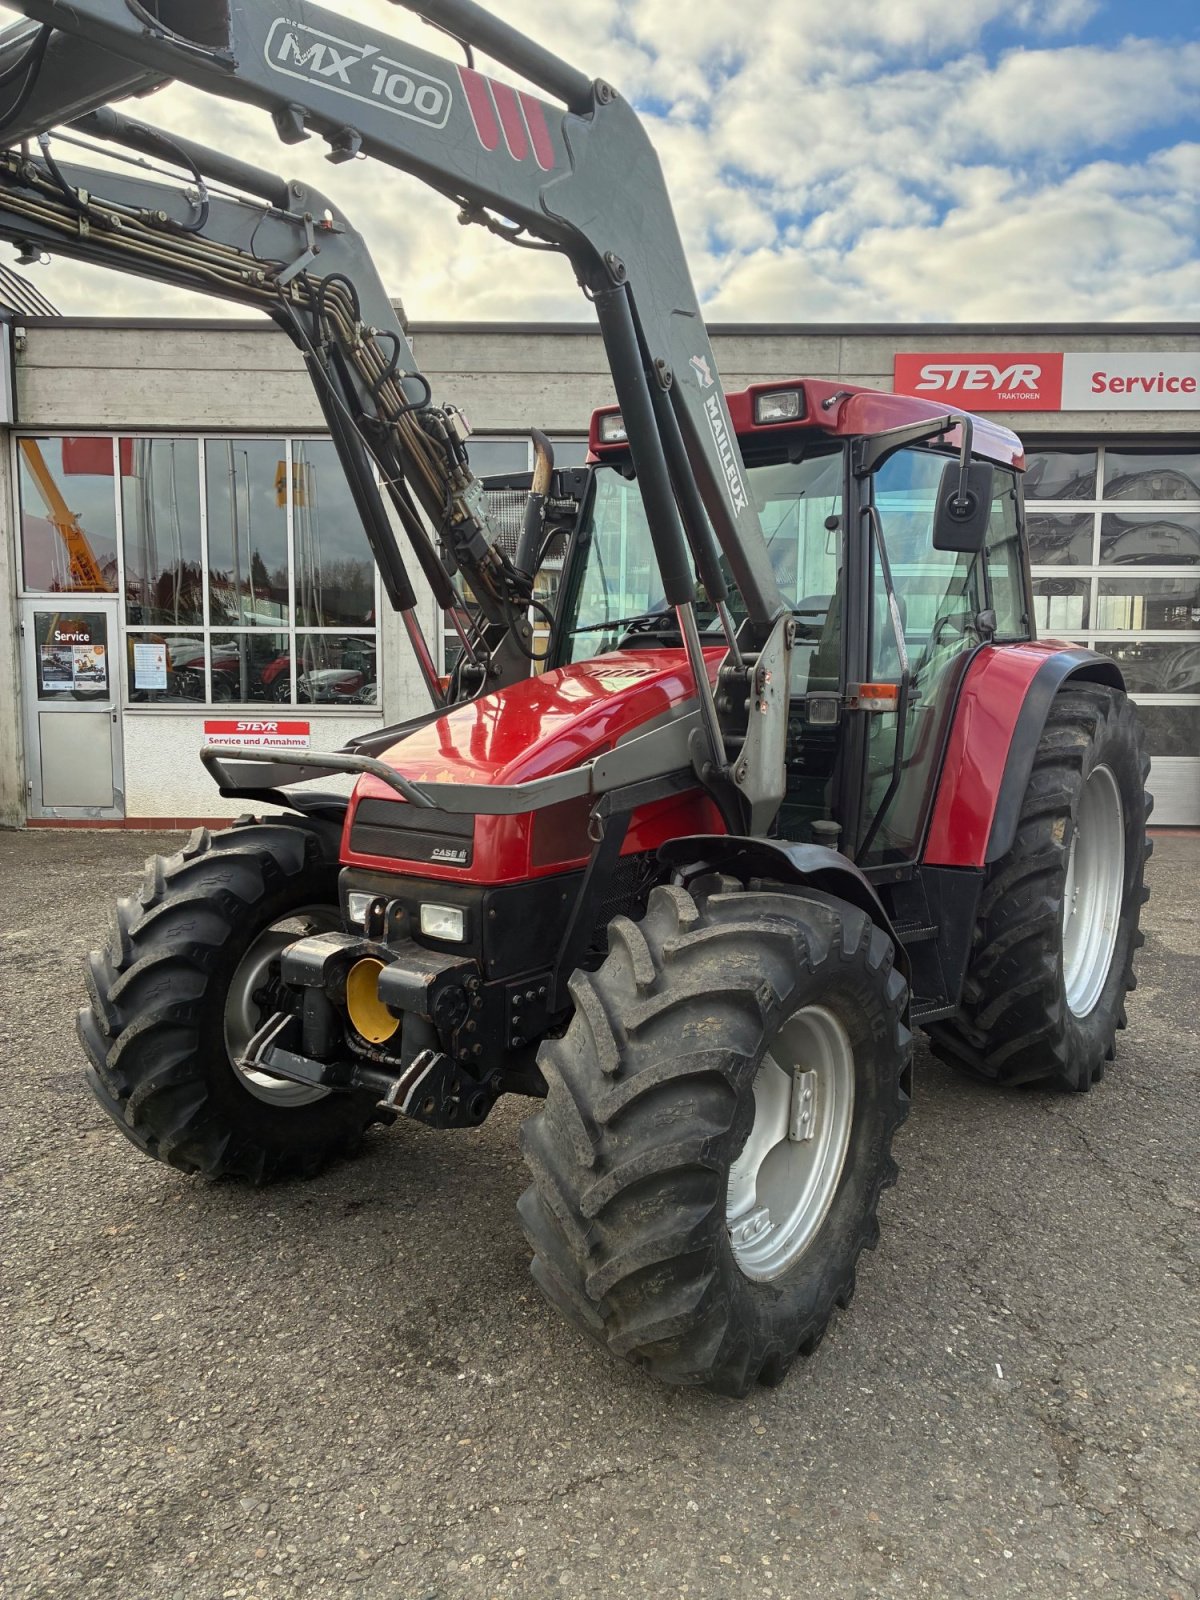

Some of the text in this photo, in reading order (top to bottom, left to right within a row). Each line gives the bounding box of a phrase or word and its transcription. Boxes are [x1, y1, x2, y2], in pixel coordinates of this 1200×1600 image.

[277, 32, 444, 116] MX 100
[914, 364, 1042, 390] STEYR
[1091, 371, 1197, 393] Service
[998, 392, 1040, 400] TRAKTOREN
[706, 394, 746, 514] MAILLEUX
[54, 630, 90, 641] Service
[236, 722, 278, 731] STEYR
[433, 849, 458, 858] CASE
